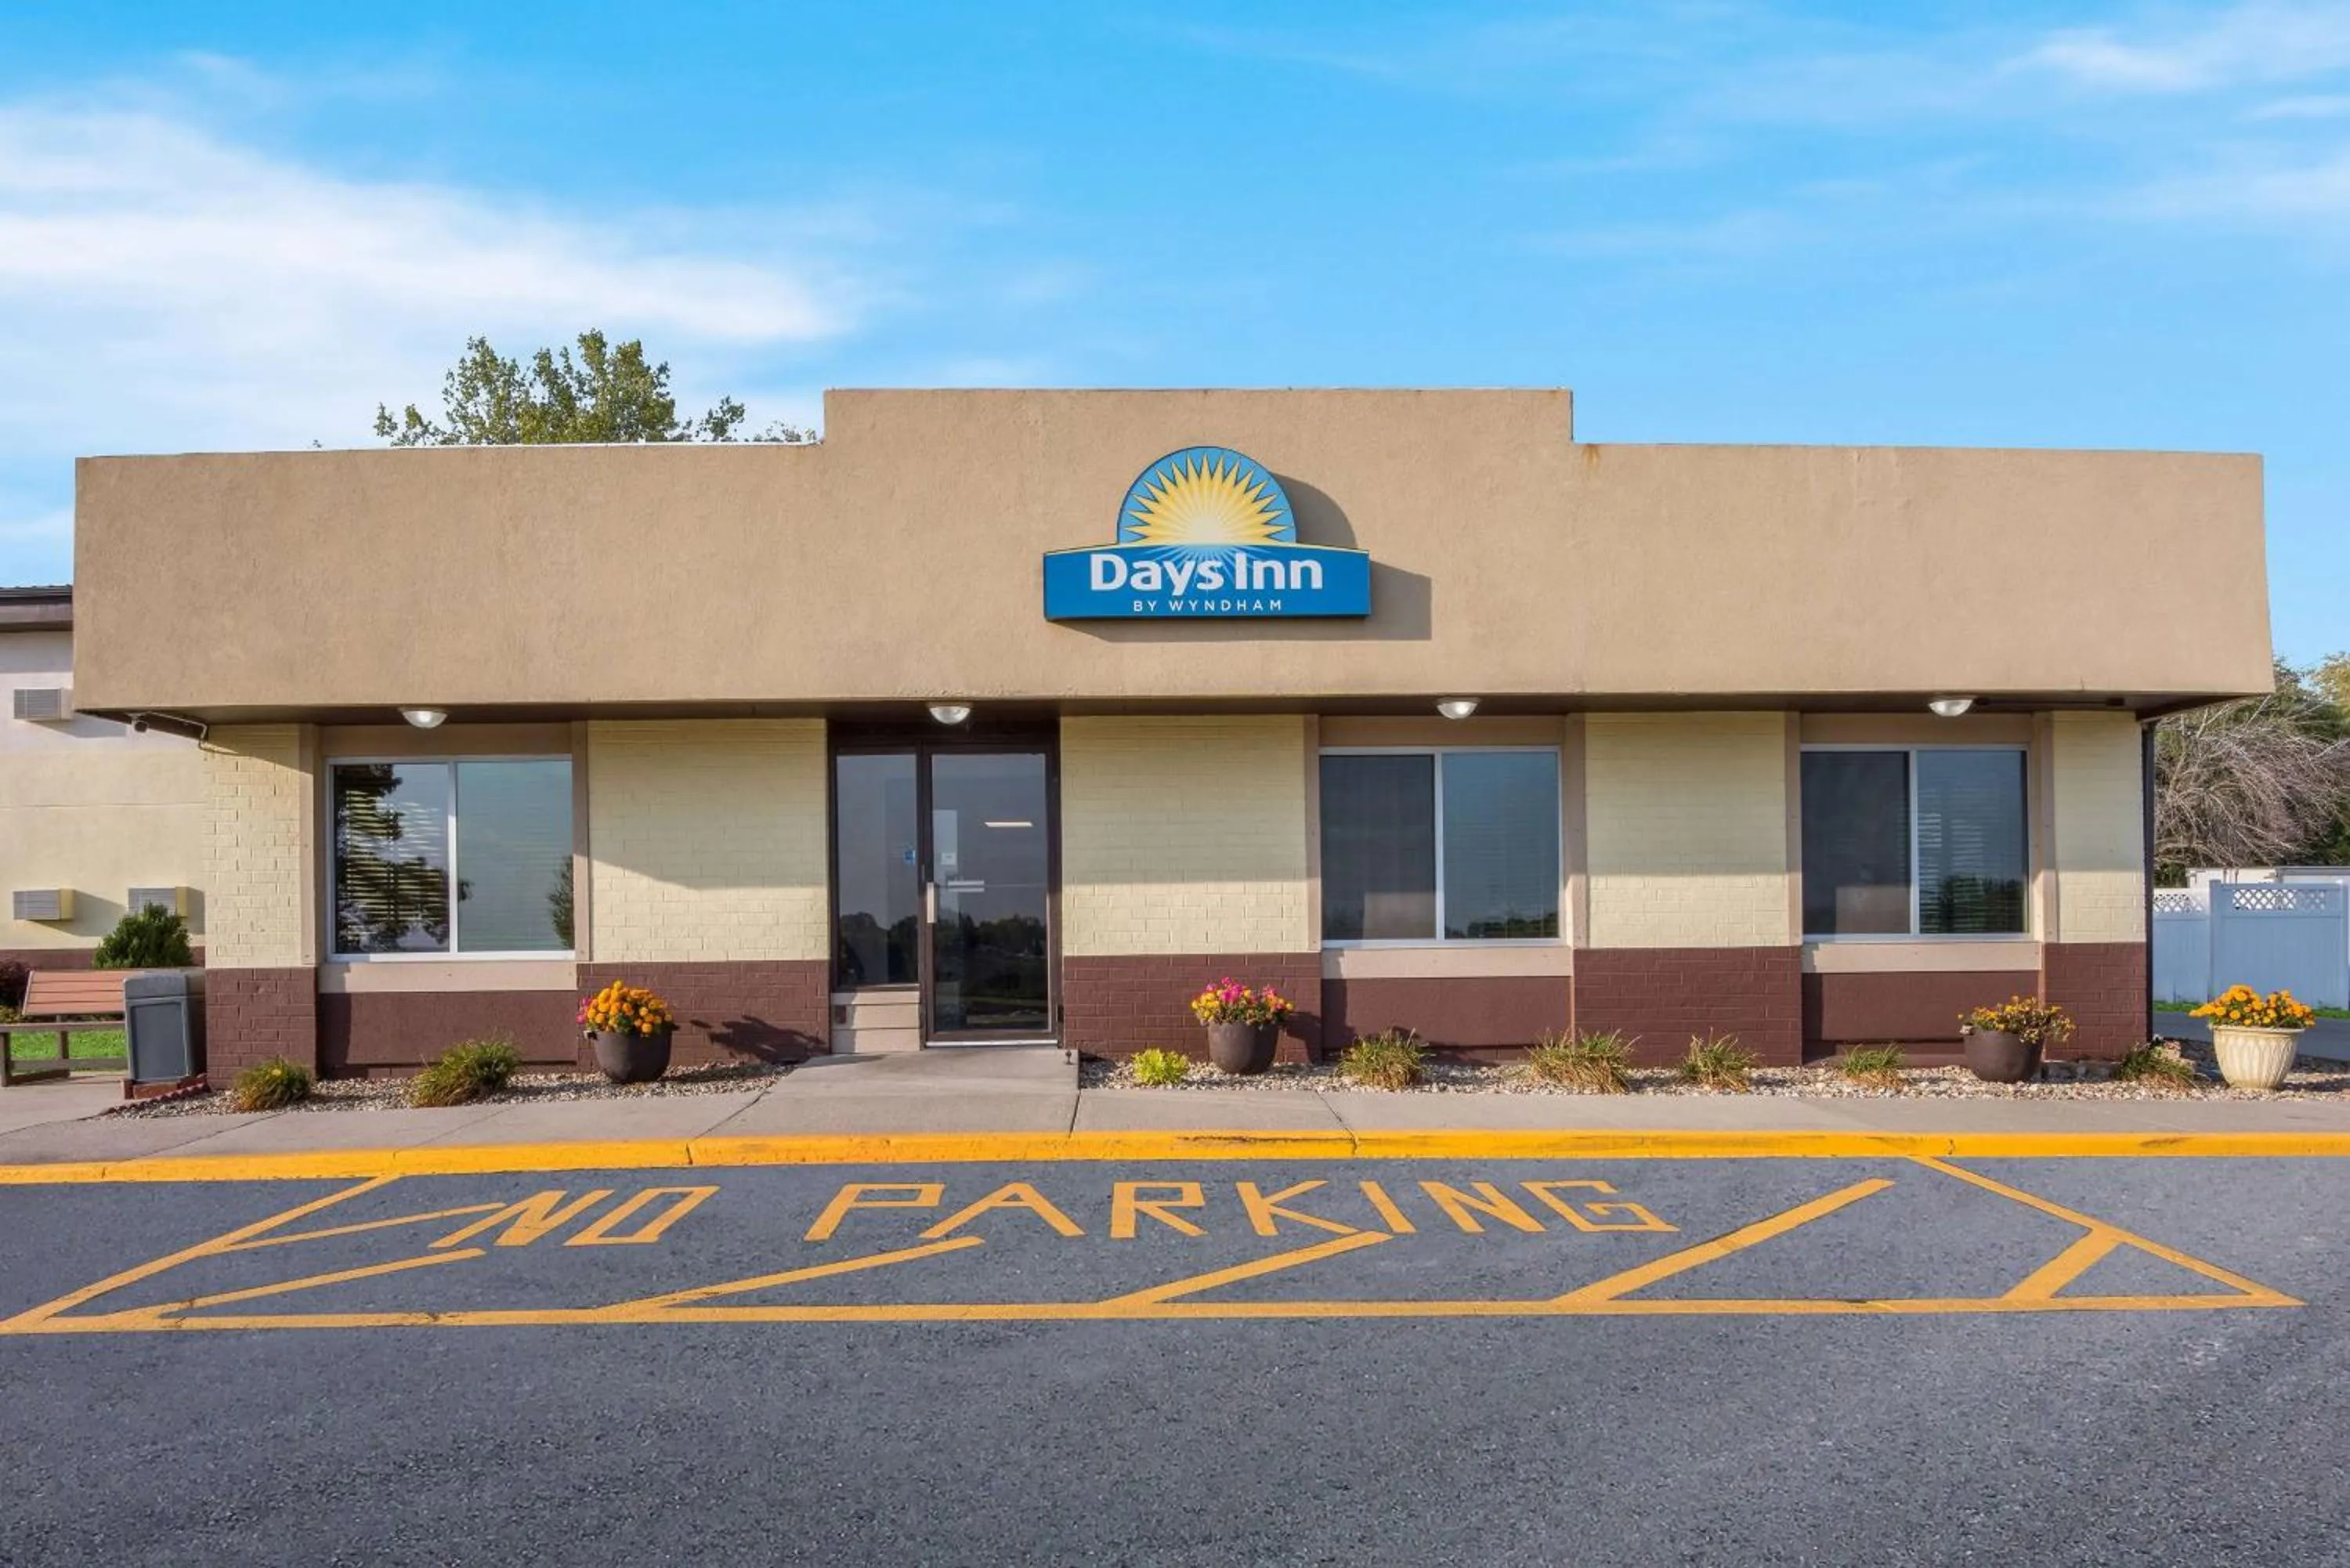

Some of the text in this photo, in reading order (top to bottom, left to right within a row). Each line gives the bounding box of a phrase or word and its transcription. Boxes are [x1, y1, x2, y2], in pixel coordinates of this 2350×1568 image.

[1090, 552, 1323, 595] Days Inn
[1133, 599, 1282, 612] BY WYNDHAM
[428, 1180, 1681, 1247] NO PARKING
